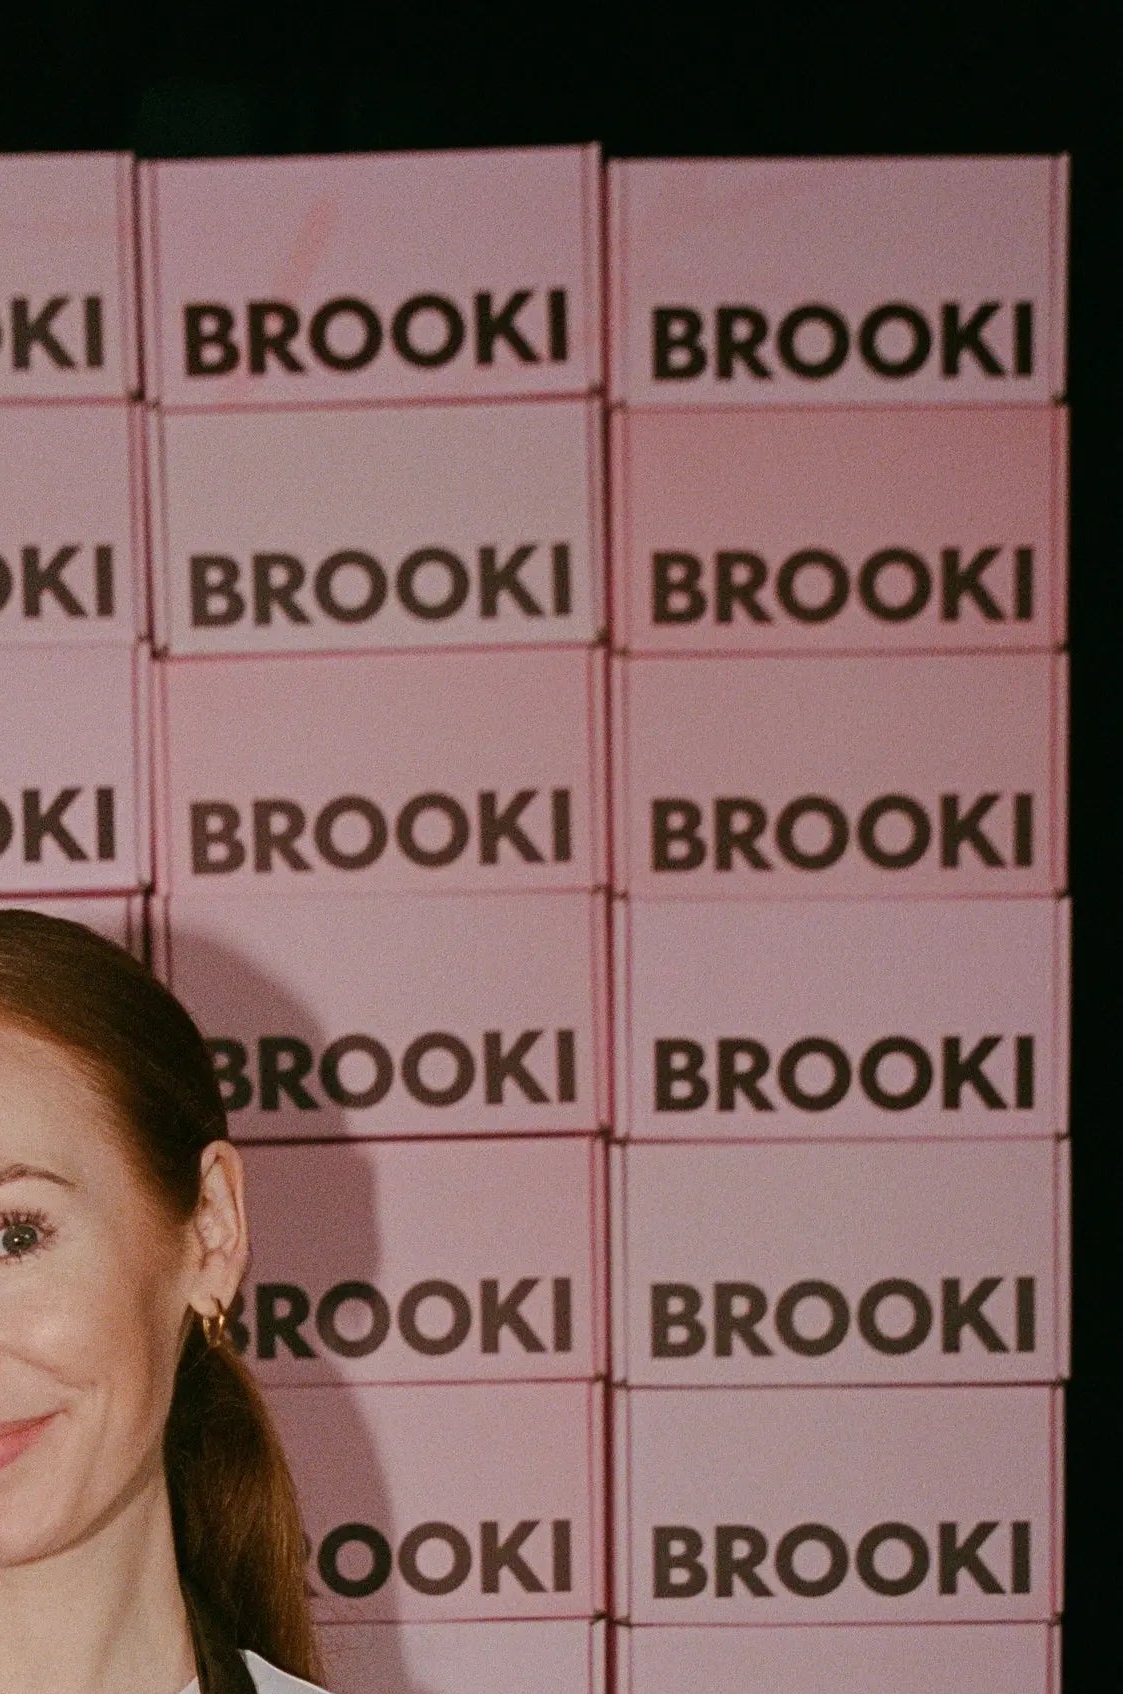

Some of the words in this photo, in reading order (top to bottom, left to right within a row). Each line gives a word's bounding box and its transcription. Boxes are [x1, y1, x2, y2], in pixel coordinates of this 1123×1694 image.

[184, 288, 568, 377] BROOKI
[653, 301, 1033, 380] BROOKI
[190, 543, 571, 627] BROOKI
[653, 546, 1034, 624] BROOKI
[191, 788, 572, 874] BROOKI
[652, 793, 1033, 871] BROOKI
[655, 1035, 1034, 1112] BROOKI
[652, 1277, 1035, 1357] BROOKI
[301, 1520, 570, 1598] OOKI
[654, 1521, 1031, 1598] BROOKI
